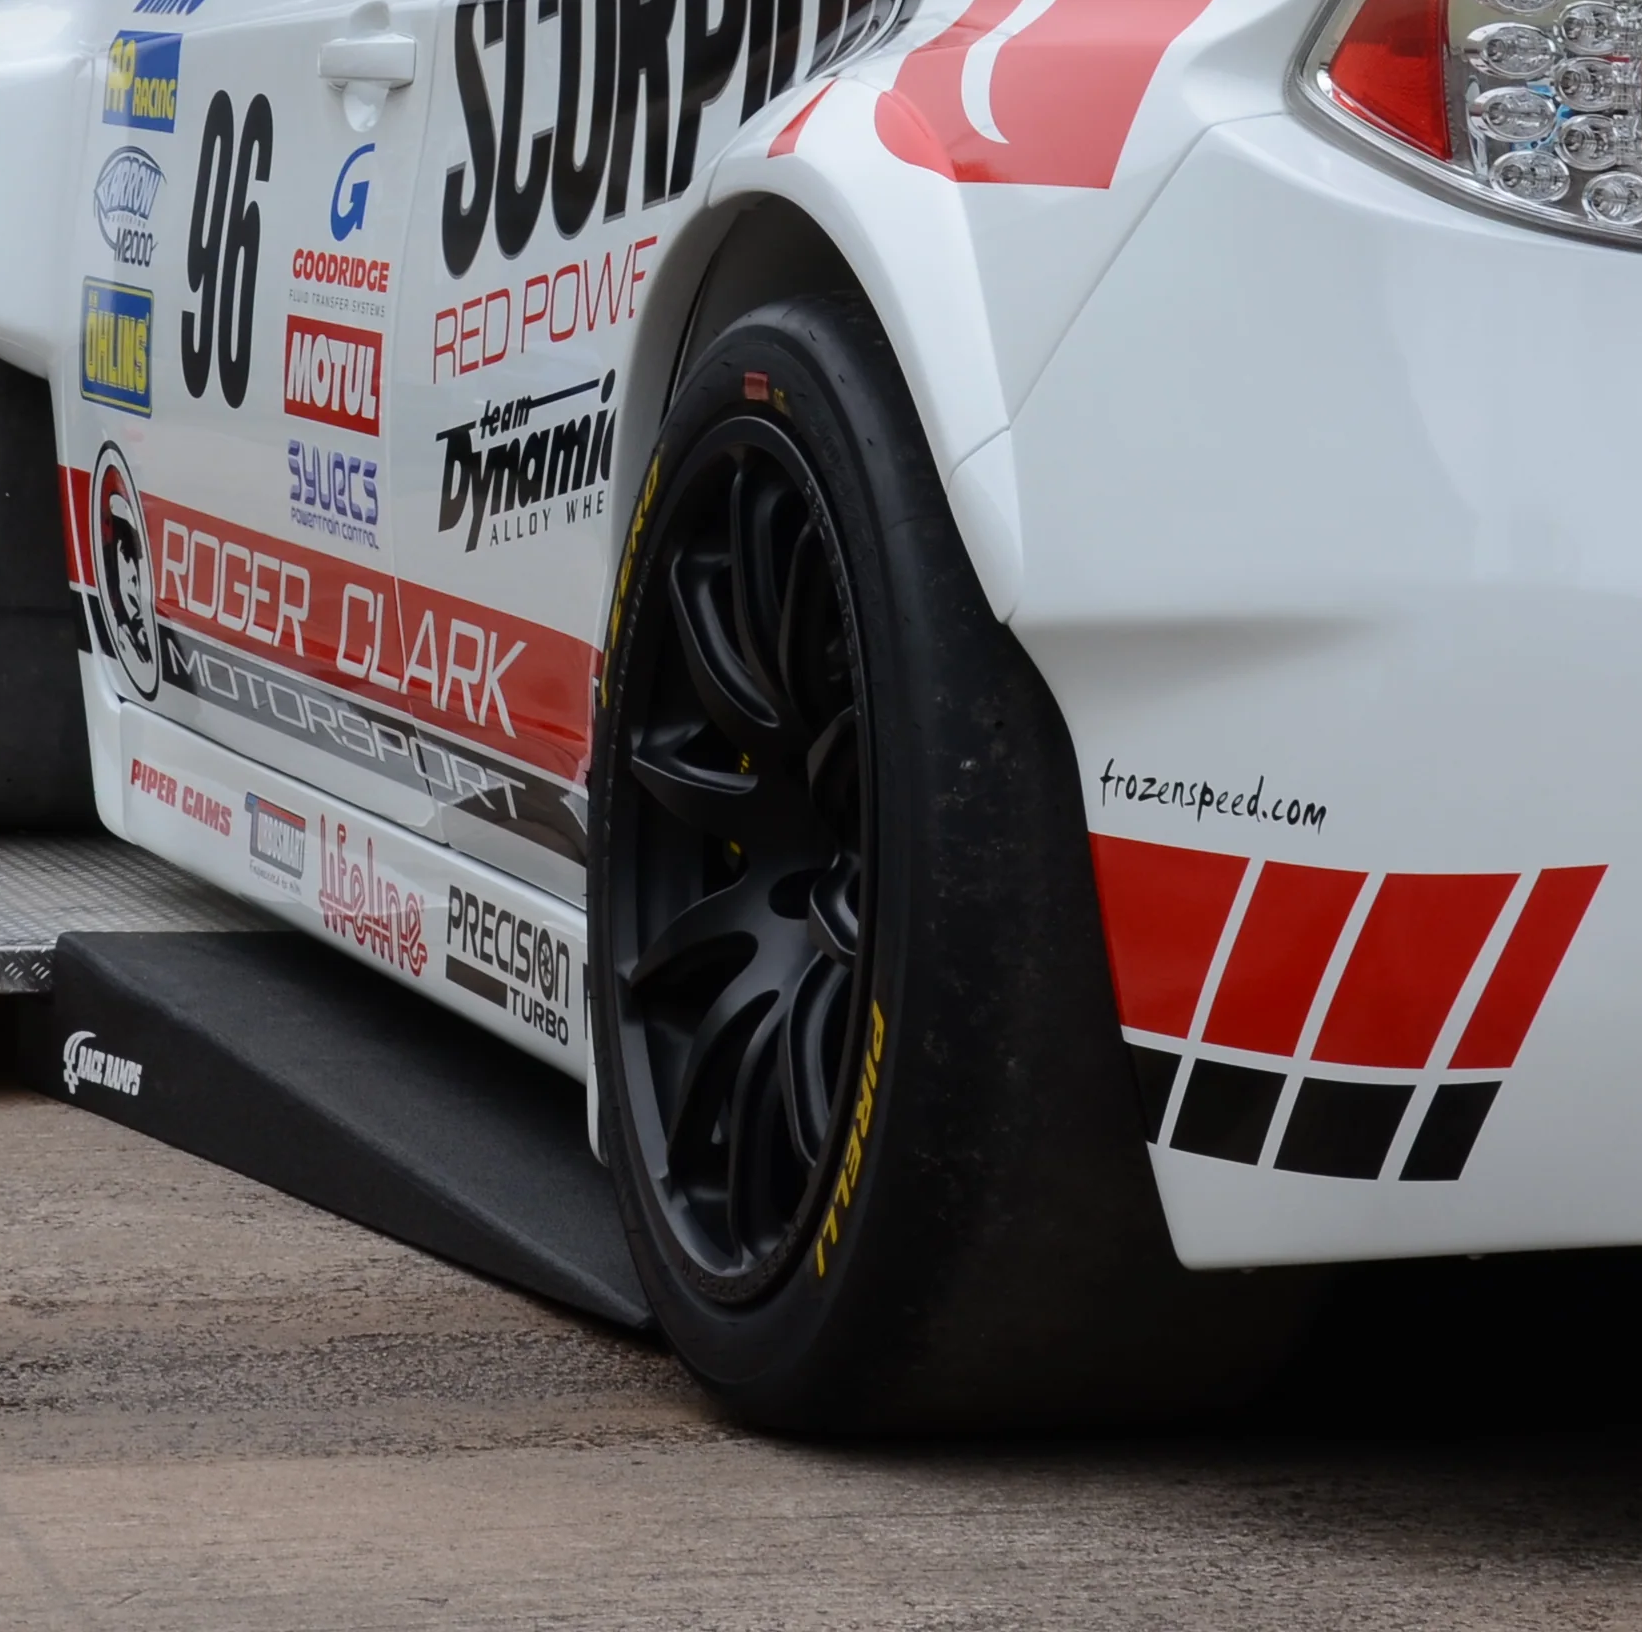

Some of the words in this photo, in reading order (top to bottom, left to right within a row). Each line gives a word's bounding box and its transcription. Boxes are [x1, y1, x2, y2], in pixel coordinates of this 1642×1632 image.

[132, 76, 177, 121] RACING
[181, 89, 274, 410] 96
[292, 248, 390, 293] GOODRIDGE
[312, 292, 349, 312] TRANSFER
[351, 299, 386, 318] SYSTEMS
[433, 287, 511, 384] RED
[286, 331, 377, 420] MOTUL
[479, 394, 534, 440] team
[489, 507, 551, 547] ALLOY
[159, 518, 311, 656] ROGER
[336, 584, 527, 739] CLARK
[167, 641, 527, 819] MOTORSPORT
[131, 759, 178, 808] PIPER
[182, 788, 233, 837] CAMS
[1099, 758, 1327, 835] frozenspeed.com
[447, 884, 570, 1009] PRECISION
[510, 986, 569, 1047] TURBO
[77, 1045, 106, 1084] RACE
[103, 1054, 143, 1097] RAMPS
[816, 1000, 885, 1277] PIRELLI
